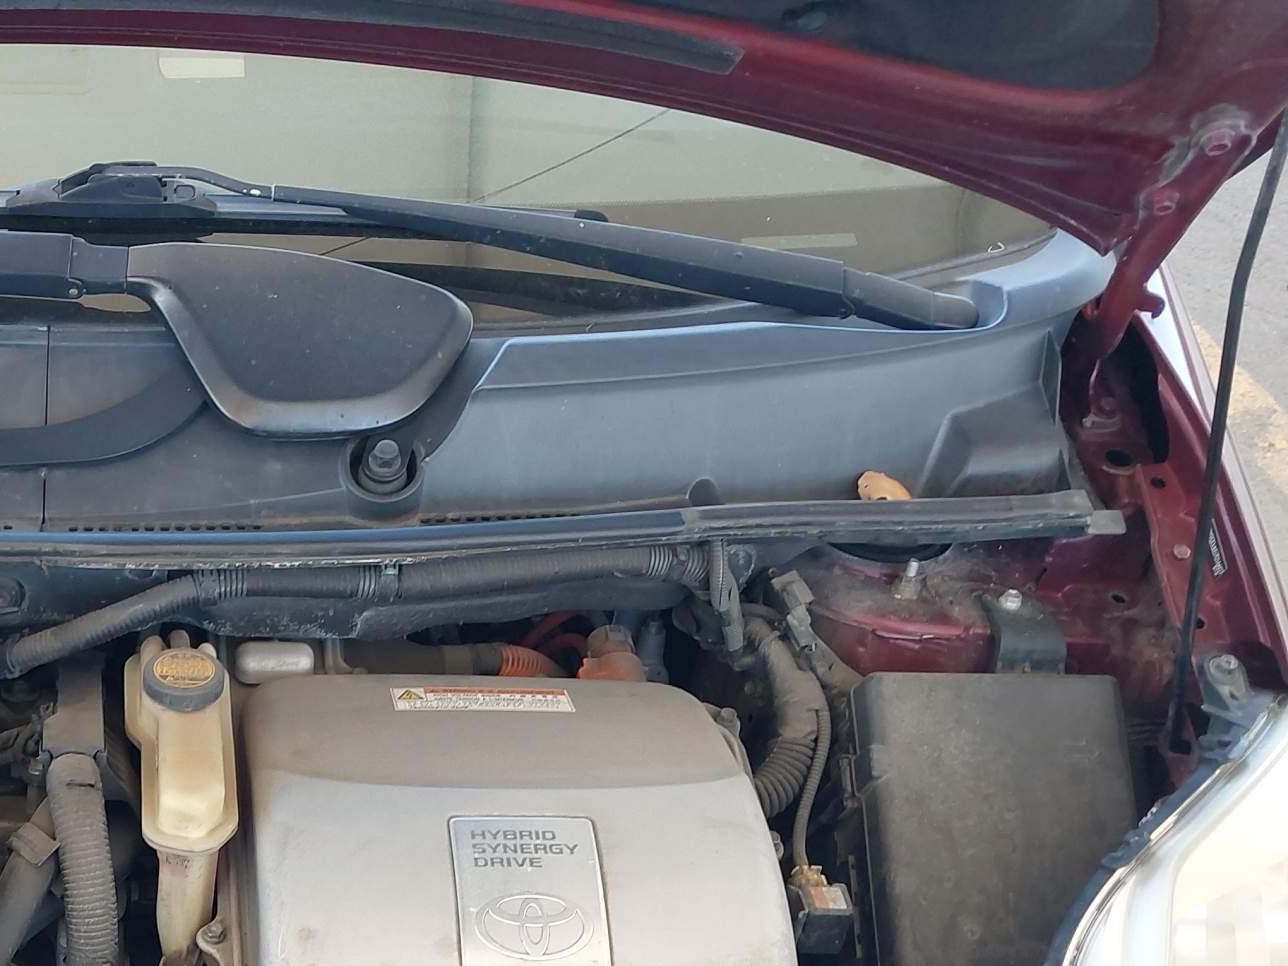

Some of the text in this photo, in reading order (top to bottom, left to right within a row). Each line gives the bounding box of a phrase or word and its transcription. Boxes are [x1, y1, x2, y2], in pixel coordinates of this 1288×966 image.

[470, 829, 556, 841] HYBRID
[472, 842, 579, 855] SYNERGY
[474, 856, 543, 868] DRIVE
